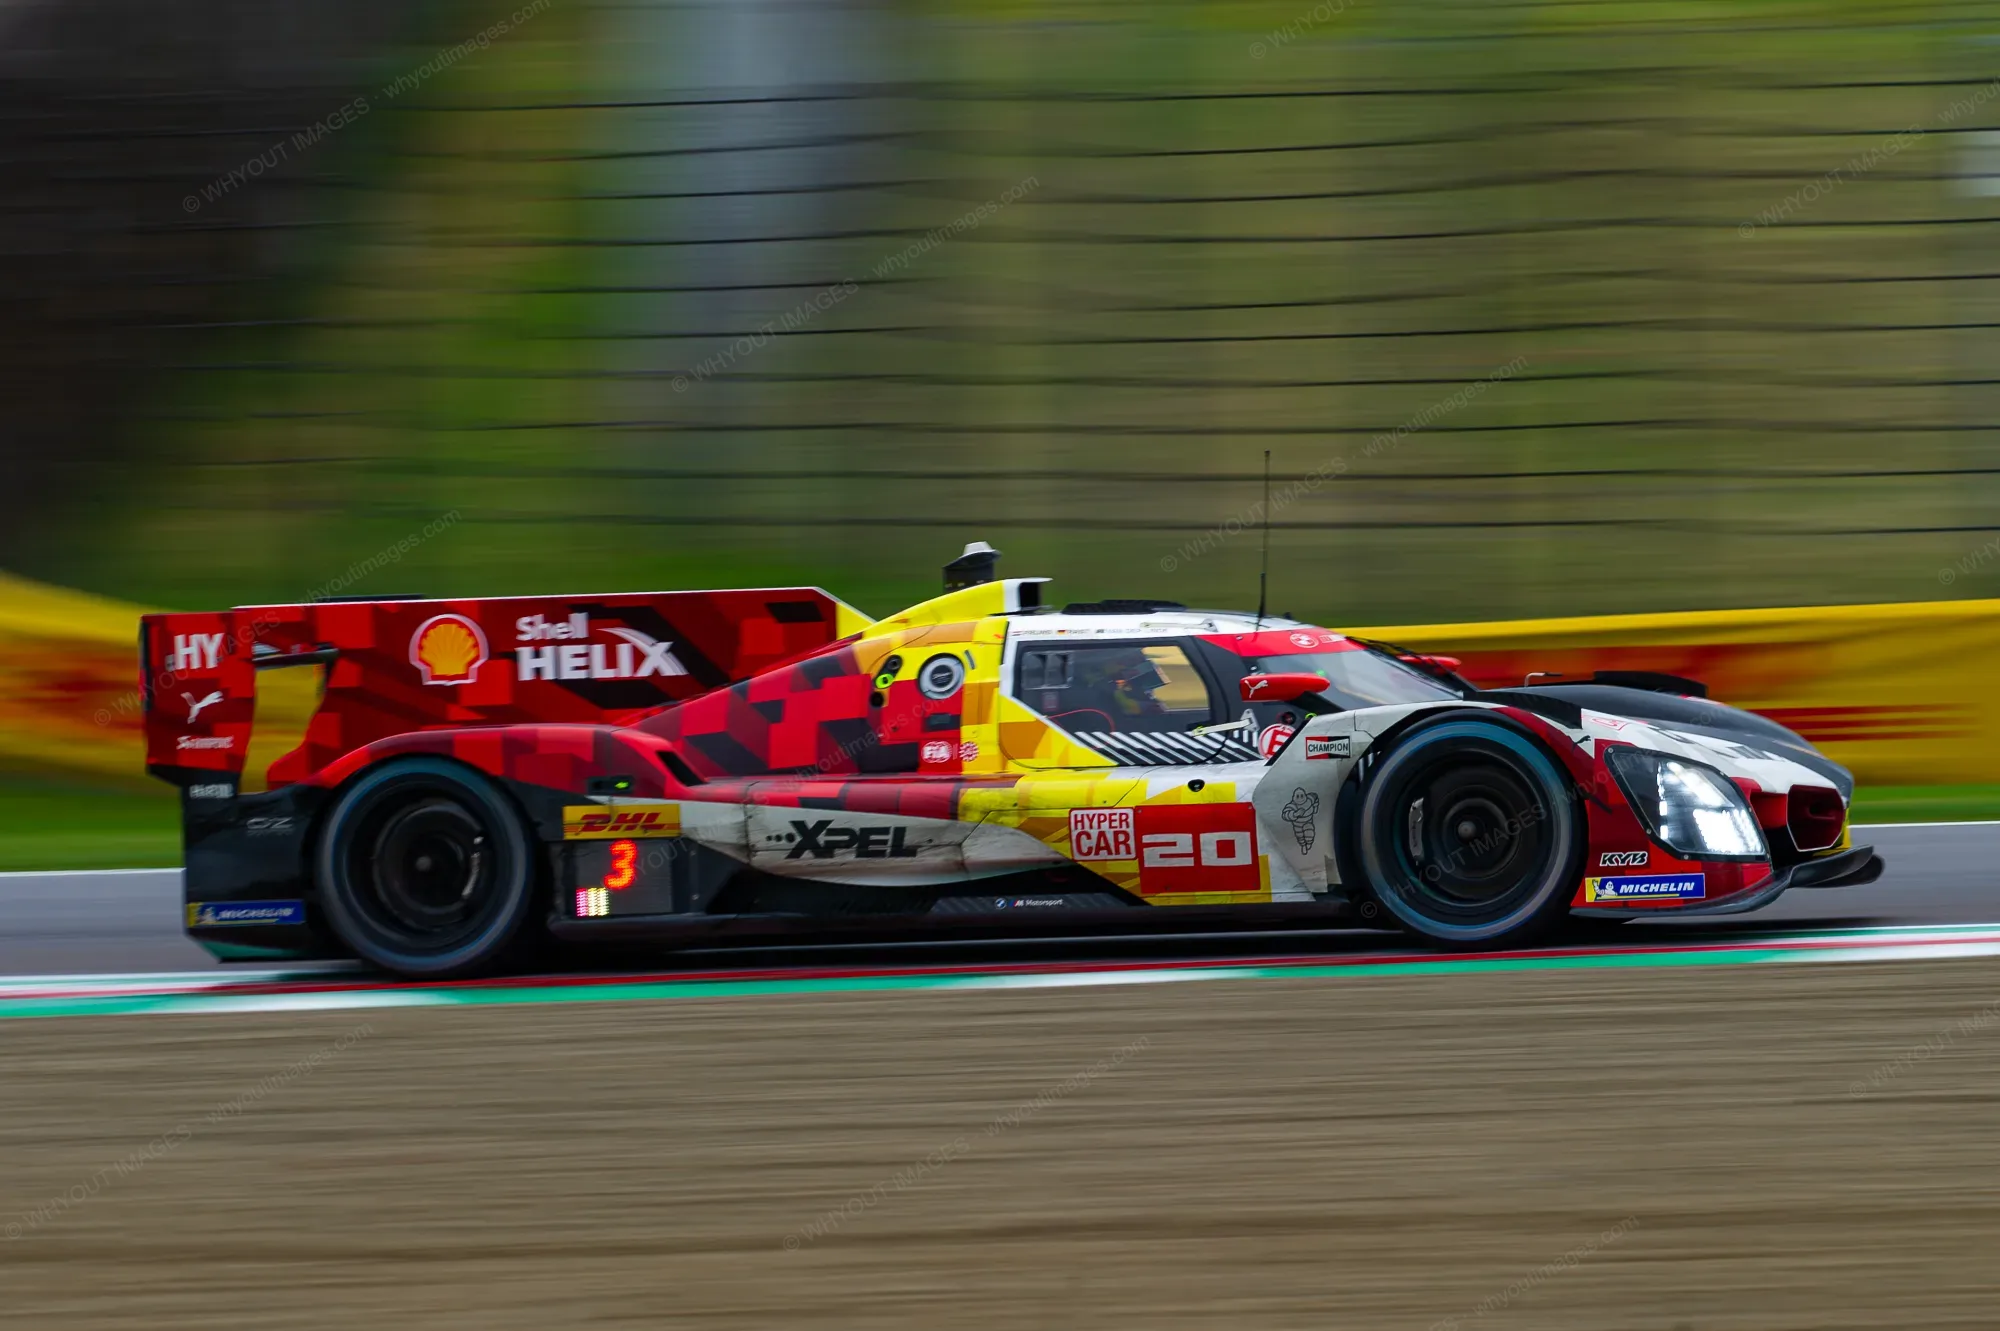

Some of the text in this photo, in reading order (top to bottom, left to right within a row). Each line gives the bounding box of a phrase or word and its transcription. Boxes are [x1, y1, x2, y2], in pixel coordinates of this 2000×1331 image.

[516, 612, 589, 641] Shell
[174, 633, 225, 670] HY
[514, 636, 689, 681] HELIX
[1308, 743, 1349, 753] CHAMPION
[580, 812, 665, 832] DHL
[1074, 811, 1130, 831] HYPER
[784, 819, 918, 859] XPEL
[1075, 829, 1132, 857] CAR
[1142, 831, 1253, 868] 20
[604, 838, 638, 890] 3
[1600, 851, 1648, 866] KYB
[1619, 880, 1695, 895] MICHELIN
